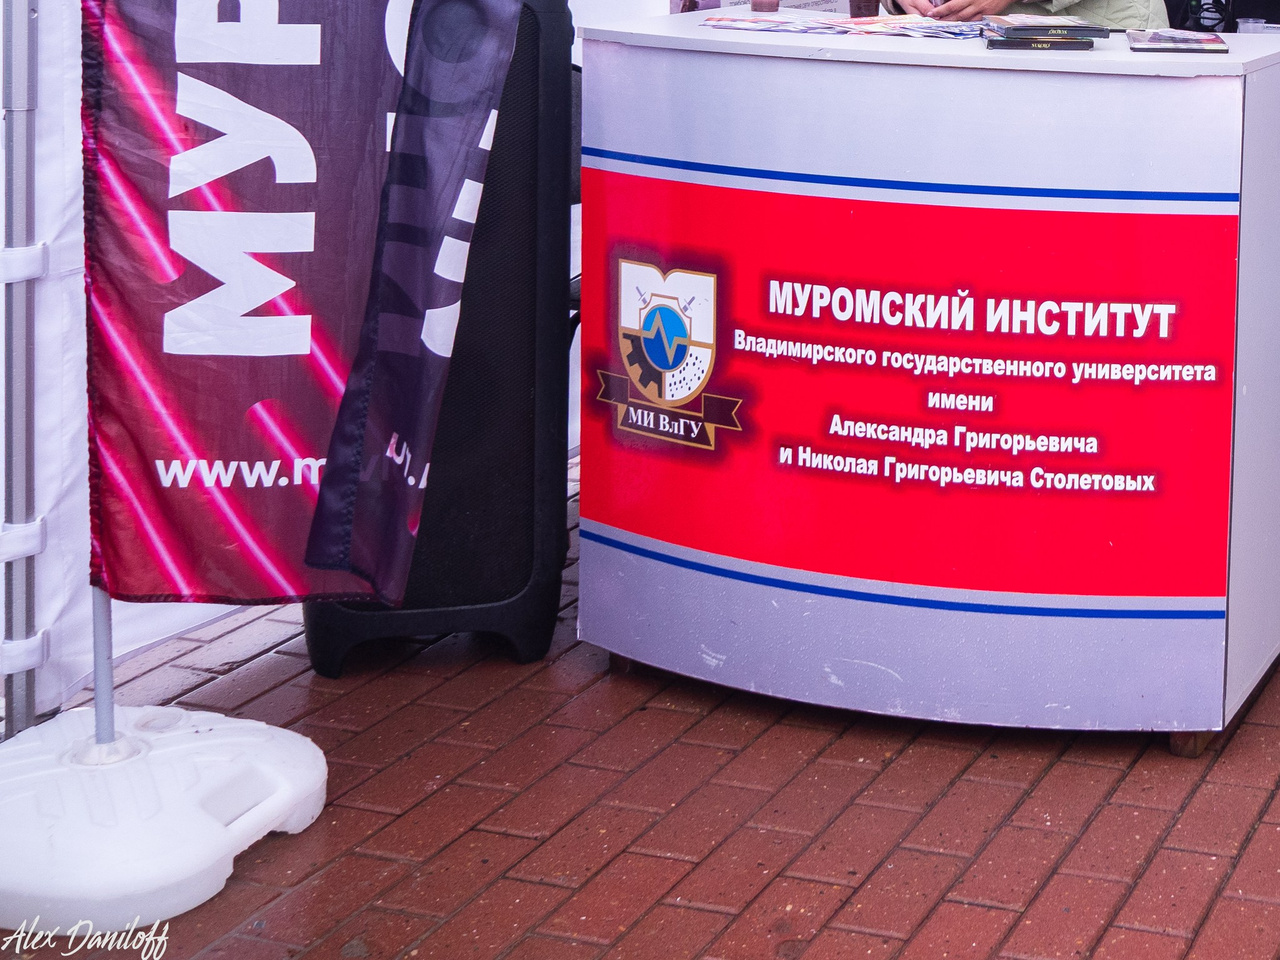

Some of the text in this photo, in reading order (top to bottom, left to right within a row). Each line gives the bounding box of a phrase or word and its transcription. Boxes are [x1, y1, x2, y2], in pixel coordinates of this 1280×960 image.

[769, 280, 1176, 338] МУРОМСКИЙ ИНСТИТУТ
[733, 329, 1216, 385] Владимирского государственного университета
[628, 406, 702, 438] МИ ВлГУ
[928, 392, 994, 412] имени
[829, 414, 1098, 455] Александра Григорьевича
[779, 446, 1155, 491] и Николая Григорьевича Столетовых
